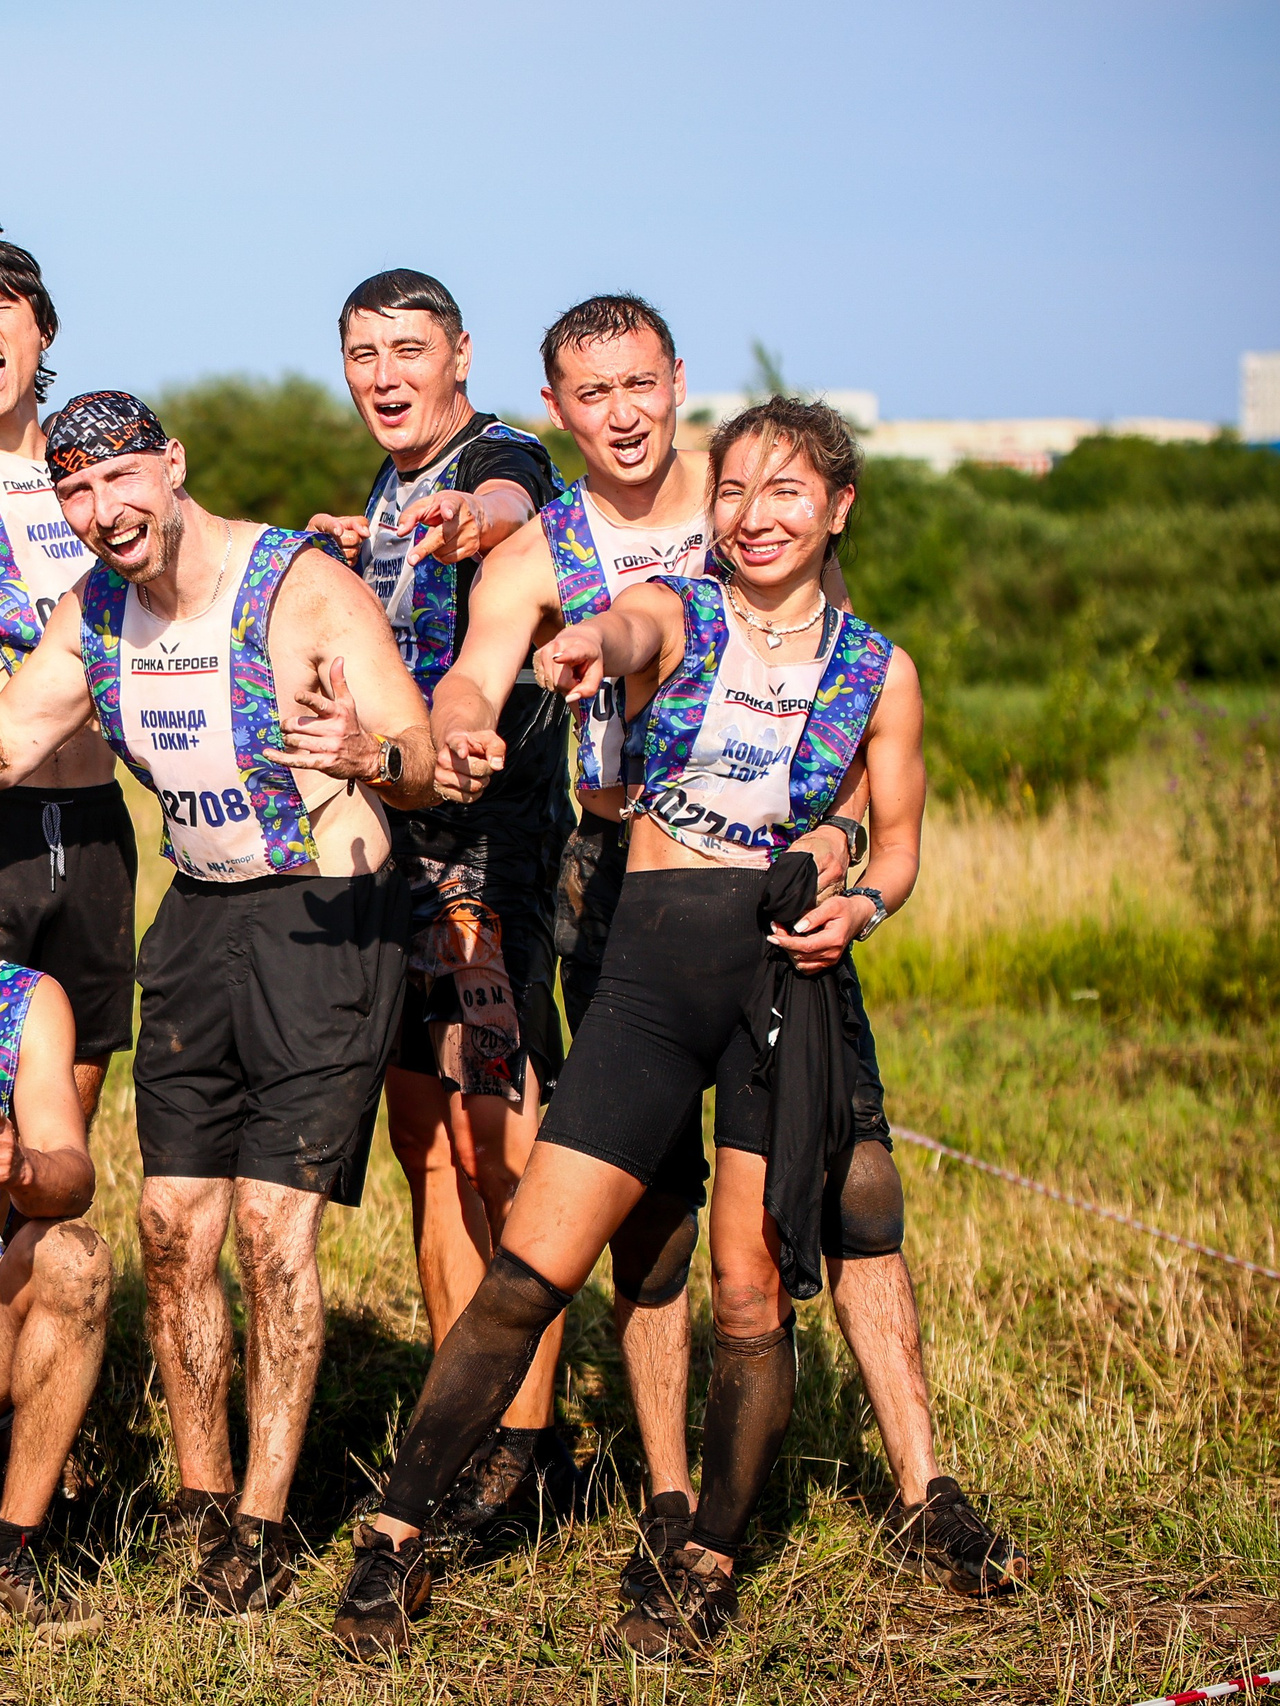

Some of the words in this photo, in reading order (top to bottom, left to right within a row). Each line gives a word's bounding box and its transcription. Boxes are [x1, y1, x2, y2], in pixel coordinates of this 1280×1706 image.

[27, 520, 76, 543] КОМА
[41, 539, 88, 560] 10КМ
[131, 658, 165, 671] ГОНКА
[168, 656, 219, 671] ГЕРОЕВ
[725, 689, 774, 713] ГОНКА
[140, 709, 208, 731] КОМАНДА
[151, 732, 200, 751] 10КМ+
[158, 788, 251, 828] 2708
